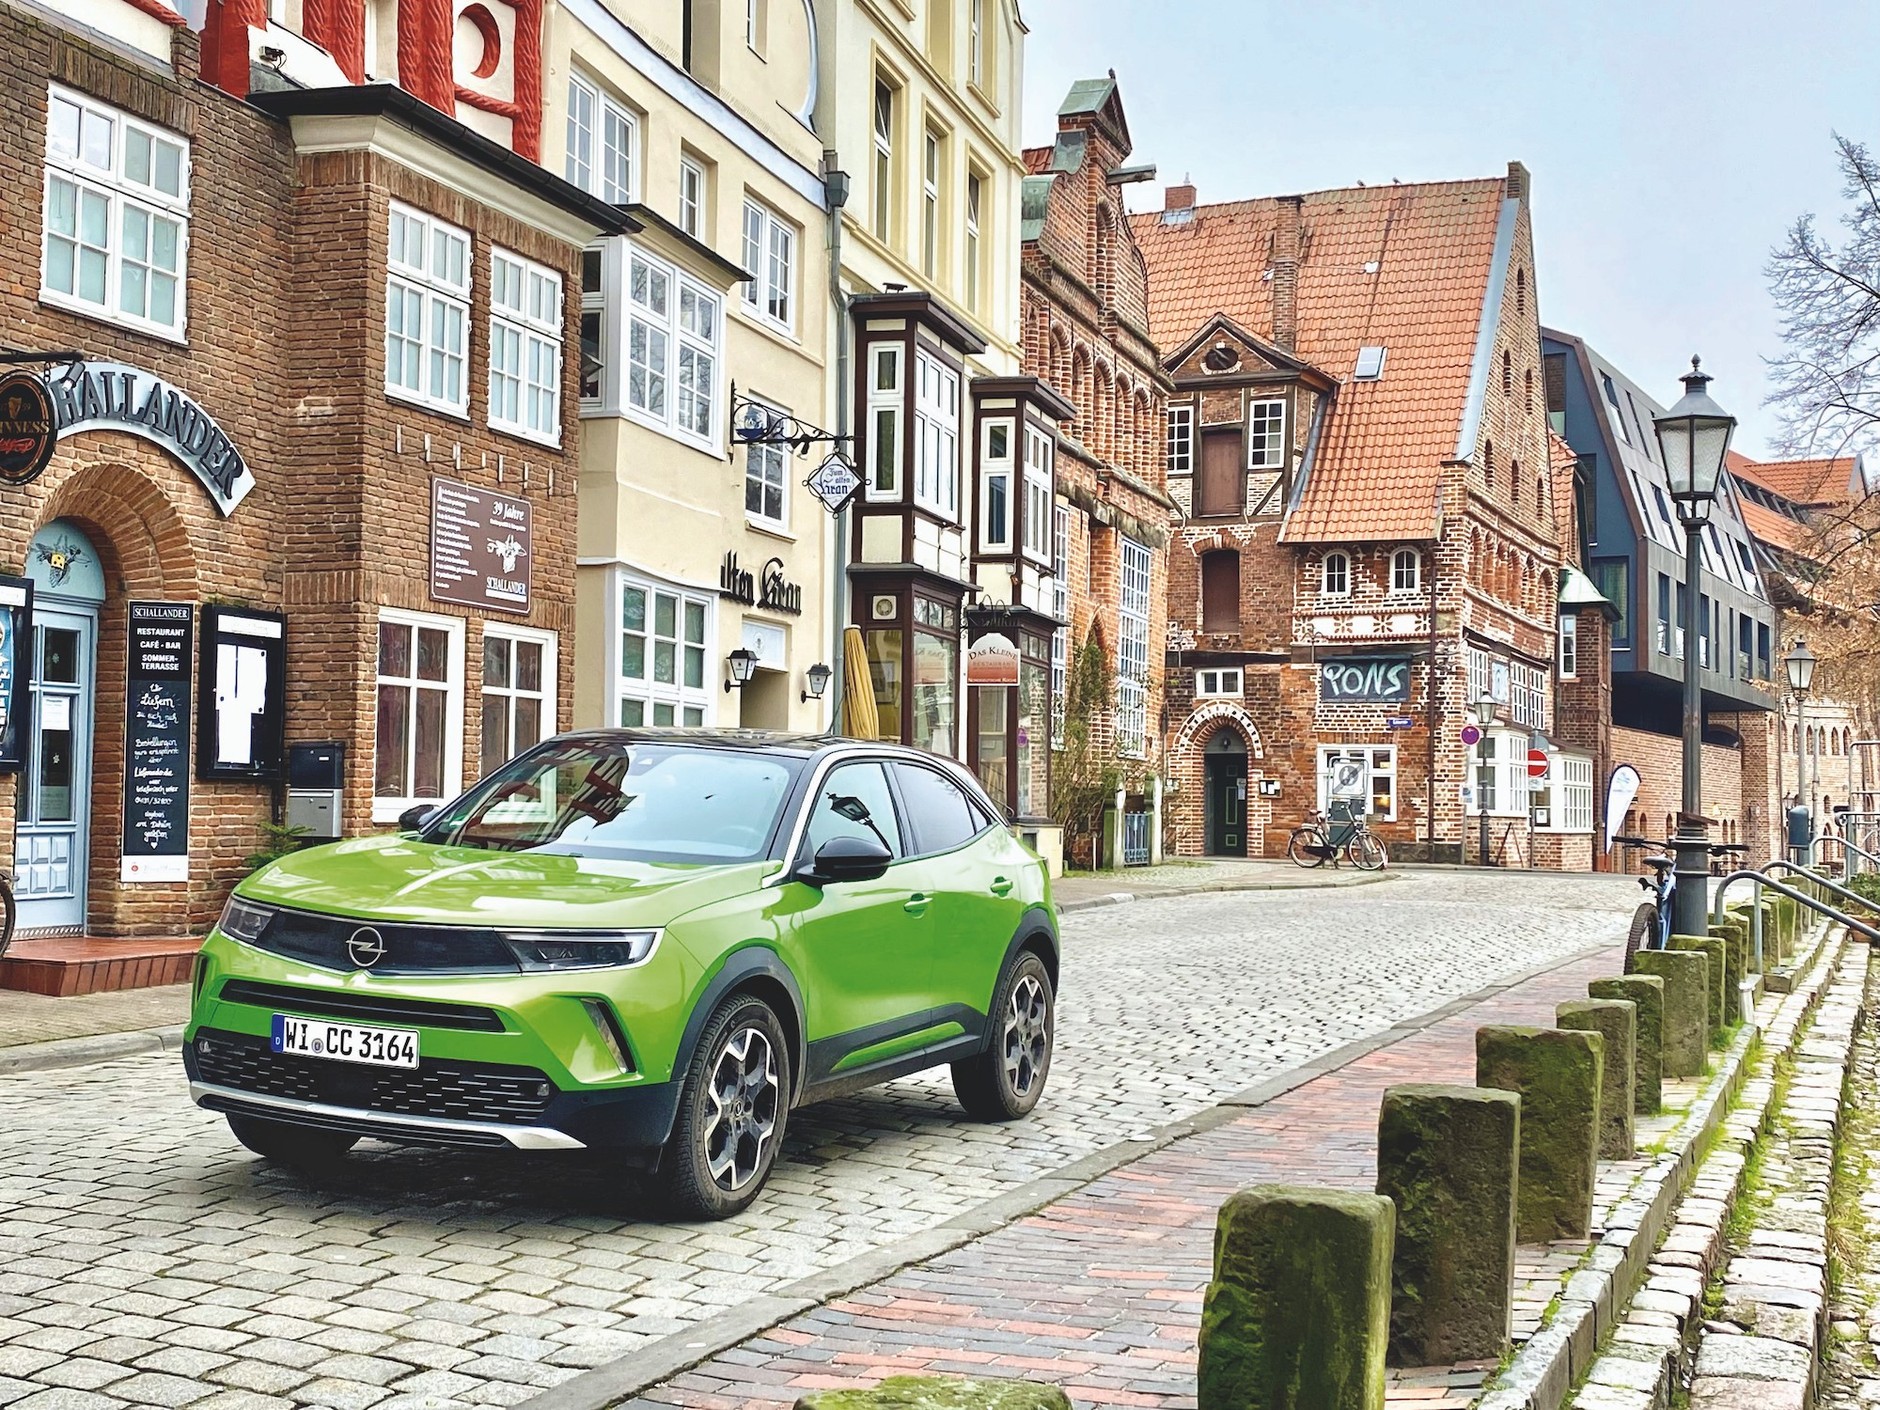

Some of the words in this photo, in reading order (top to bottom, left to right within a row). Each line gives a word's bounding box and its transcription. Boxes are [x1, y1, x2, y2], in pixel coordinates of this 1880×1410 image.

[0, 421, 49, 433] INNESS
[50, 371, 243, 500] HALLANDER
[493, 501, 503, 515] 39
[503, 503, 525, 521] Jahre
[486, 576, 526, 595] SCHALLANDER
[134, 607, 188, 618] SCHALLANDER
[136, 627, 186, 637] RESTAURANT
[140, 640, 160, 649] CAFÉ
[165, 641, 181, 650] BAR
[142, 654, 179, 662] SOMMER-
[969, 649, 987, 660] DAS
[989, 646, 1018, 660] KLEINE
[141, 662, 180, 671] TERRASSE
[1323, 662, 1407, 697] PONS
[286, 1021, 308, 1050] WI
[326, 1027, 353, 1056] CC
[359, 1031, 414, 1063] 3164
